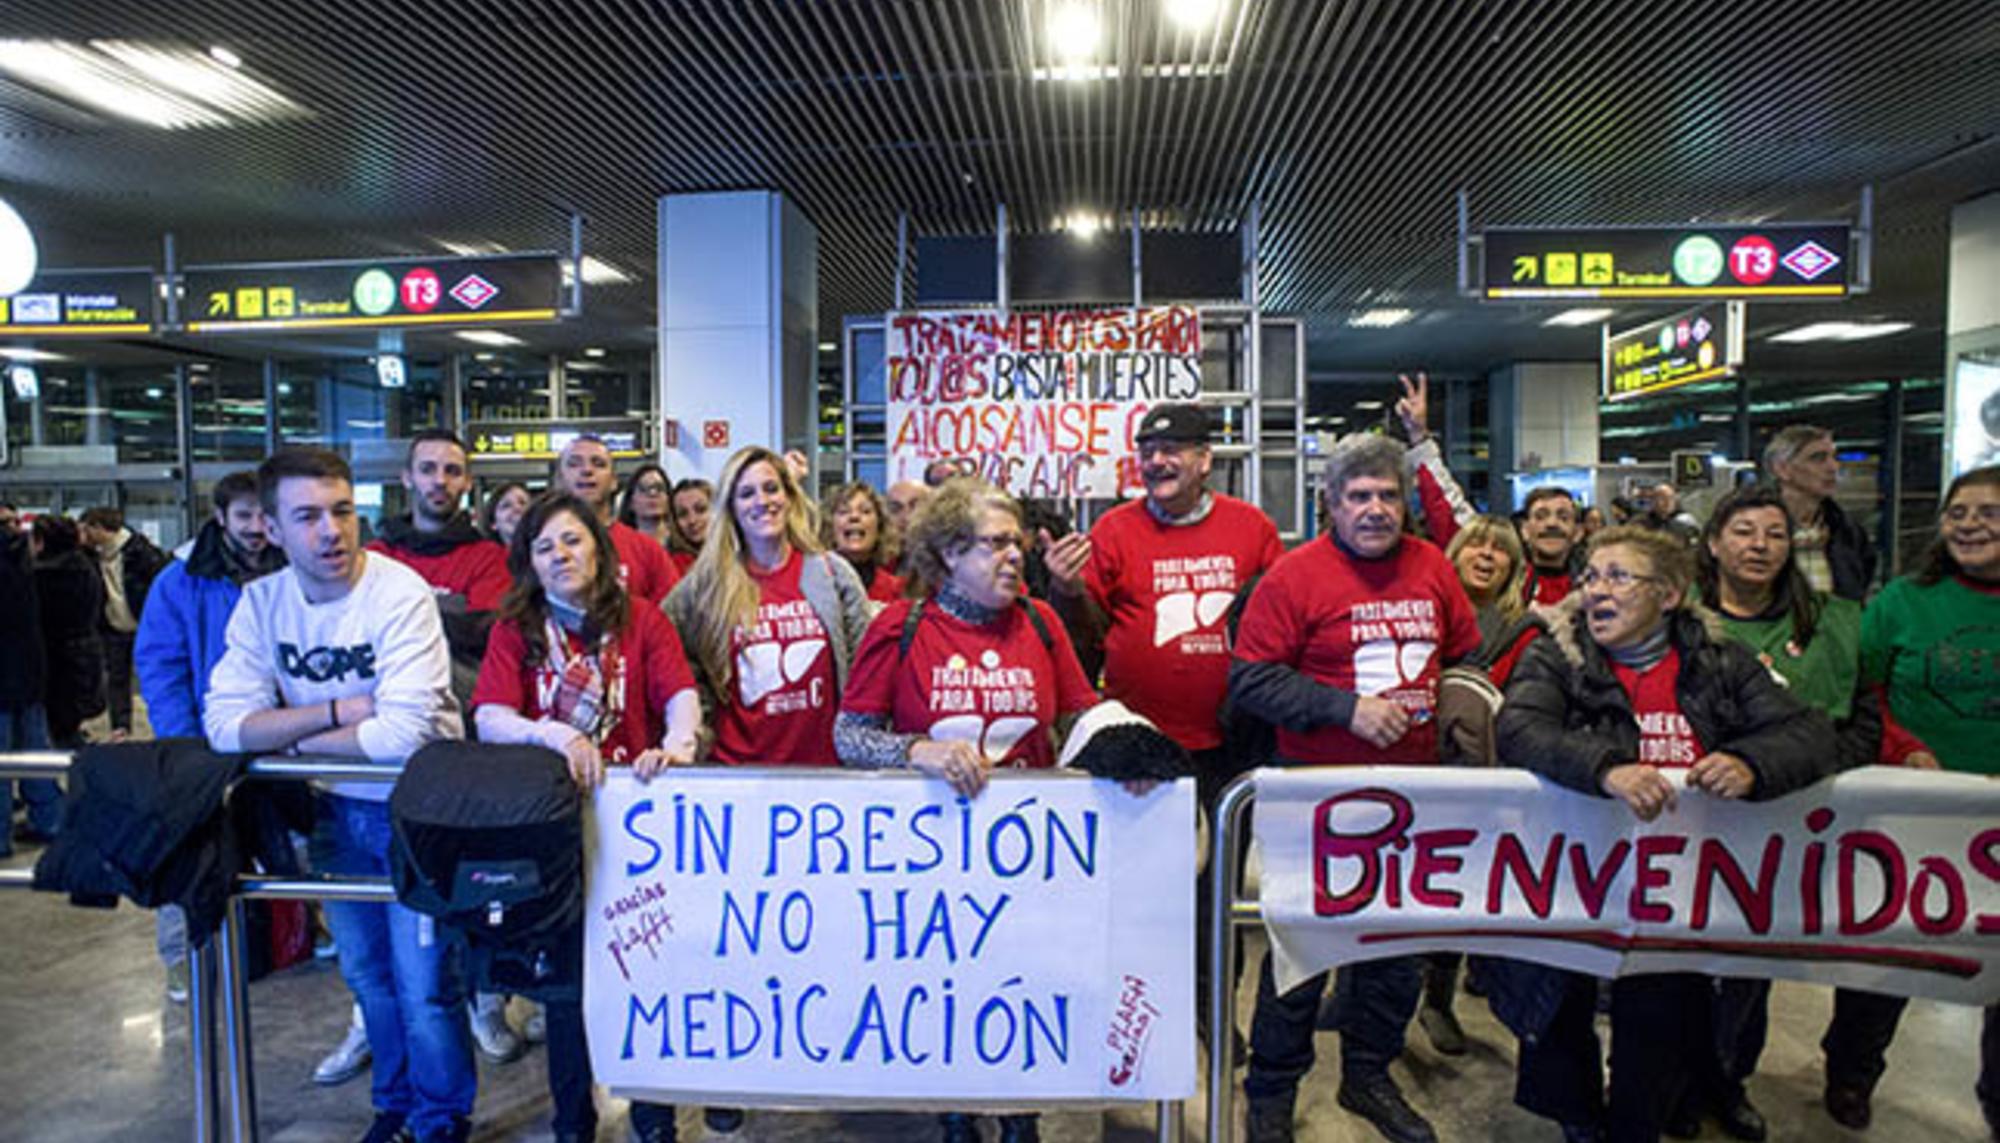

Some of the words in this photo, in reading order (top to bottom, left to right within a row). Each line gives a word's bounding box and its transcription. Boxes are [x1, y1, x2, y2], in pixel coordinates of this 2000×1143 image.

[1616, 271, 1671, 285] Terminal
[1683, 246, 1717, 275] T2
[1733, 245, 1773, 276] T3
[406, 277, 439, 305] T3
[1153, 574, 1189, 593] PARA
[277, 641, 377, 684] DOPE
[929, 688, 976, 713] PARA
[623, 794, 734, 878] SIN
[763, 795, 1099, 881] PRESIÓN
[715, 889, 814, 957] NO
[858, 889, 1012, 963] HAY
[620, 976, 1070, 1071] MEDICACIÓN
